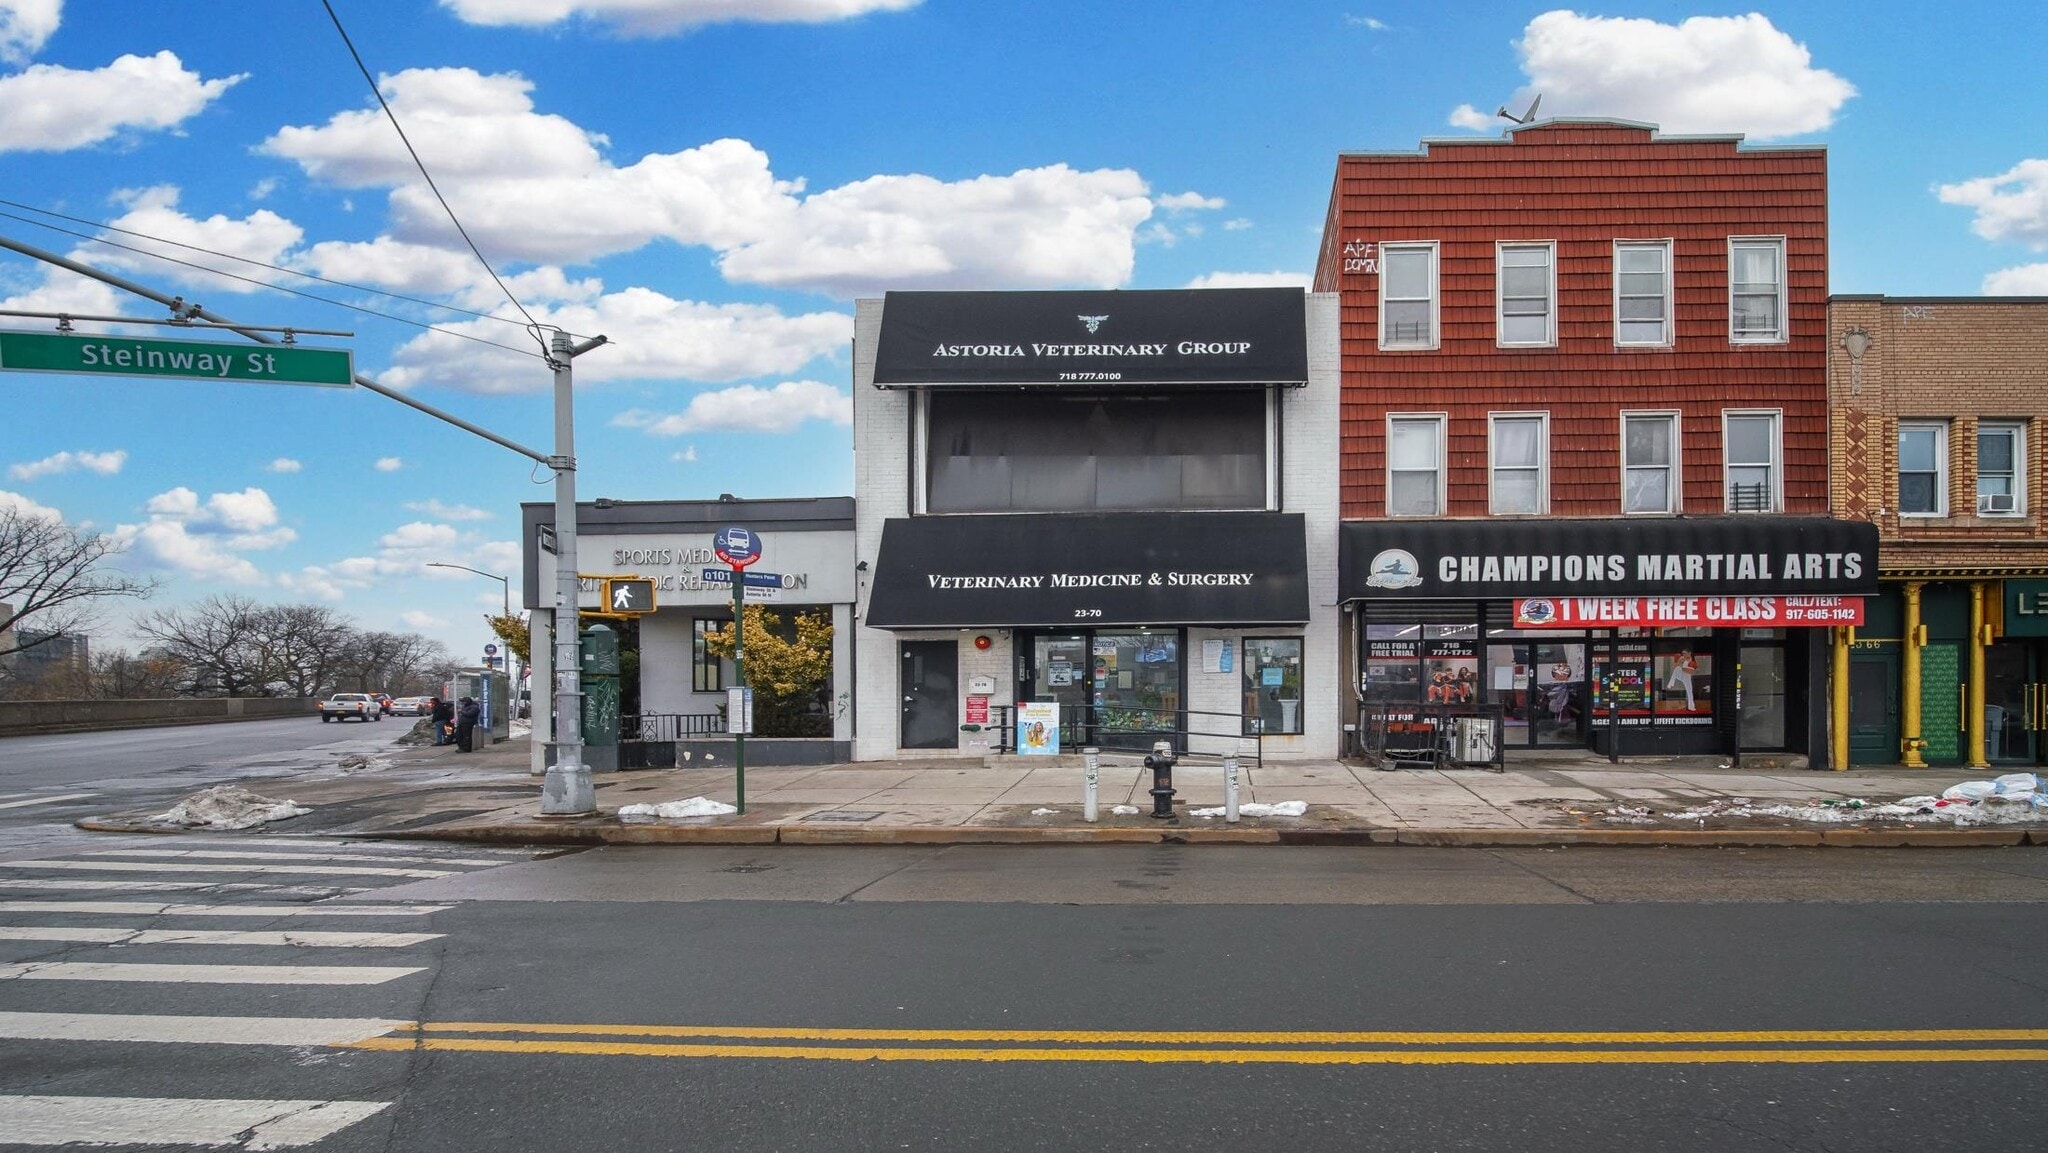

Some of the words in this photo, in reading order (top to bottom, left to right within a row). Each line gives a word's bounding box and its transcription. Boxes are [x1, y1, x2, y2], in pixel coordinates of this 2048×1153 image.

[933, 343, 1025, 358] ASTORIA
[1032, 343, 1168, 357] VETERINARY
[1177, 341, 1251, 356] GROUP
[81, 344, 232, 376] Steinway
[248, 353, 276, 374] St
[614, 548, 671, 565] SPORTS
[718, 552, 729, 561] NO
[729, 554, 759, 565] STANDING
[681, 565, 692, 574] &
[1438, 554, 1625, 583] CHAMPIONS
[1637, 553, 1772, 581] MARTIAL
[1783, 552, 1862, 579] ARTS
[704, 571, 731, 581] Q101
[928, 574, 1044, 589] VETERINARY
[1051, 573, 1142, 588] MEDICINE
[1147, 573, 1162, 586] &
[1167, 571, 1254, 586] SURGERY
[1785, 597, 1842, 607] CALL/TEXT:
[1074, 609, 1102, 617] 23-70
[1560, 599, 1570, 621] 1
[1577, 598, 1640, 621] WEEK
[1647, 598, 1698, 620] FREE
[1706, 598, 1776, 620] CLASS
[1785, 608, 1855, 620] 917-605-1142
[1371, 642, 1391, 650] CALL
[1392, 642, 1408, 650] FOR
[1408, 642, 1415, 650] A
